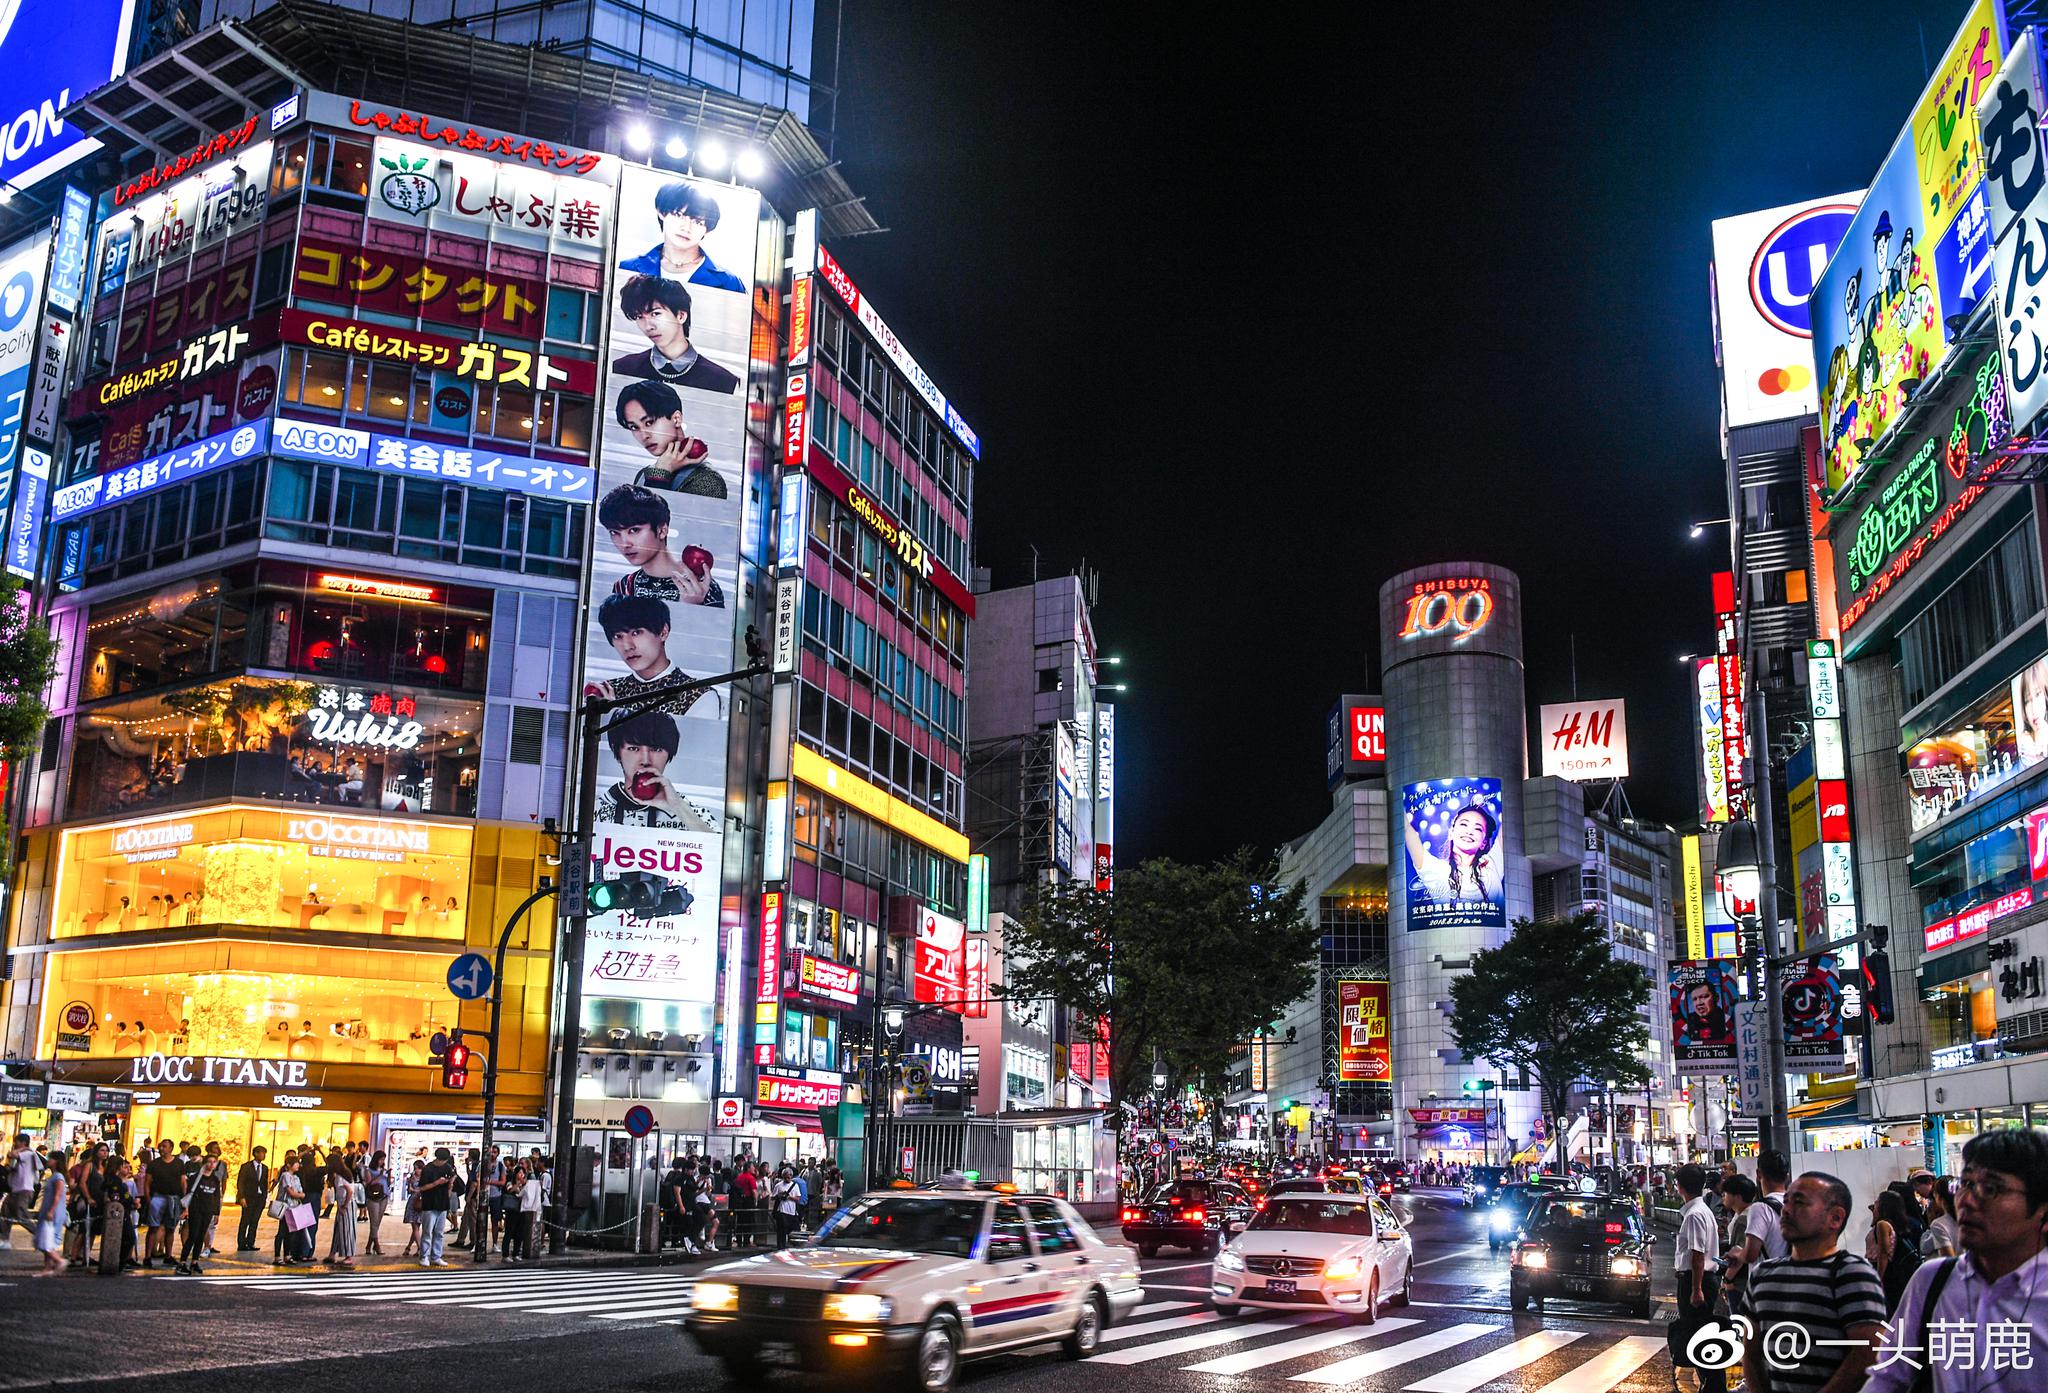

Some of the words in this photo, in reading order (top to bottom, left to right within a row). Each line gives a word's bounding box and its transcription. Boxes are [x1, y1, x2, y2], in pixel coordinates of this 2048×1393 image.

[1920, 26, 1993, 185] フレンズ
[350, 101, 601, 175] しゃぶしゃぶバイキング
[456, 176, 600, 238] しゃぶ葉
[1984, 80, 2048, 392] もんじ
[298, 247, 538, 322] コンタクト
[122, 268, 248, 351] プライス
[181, 325, 249, 380] ガスト
[456, 343, 568, 391] ガスト
[36, 345, 60, 425] 献血ルーム
[34, 427, 48, 439] 6F
[143, 395, 226, 457] ガスト
[788, 412, 803, 456] ガスト
[57, 484, 96, 514] AEON
[106, 441, 226, 500] 英会話イーオン
[282, 428, 358, 459] AEON
[376, 439, 588, 492] 英会話イーオン
[1884, 460, 1937, 552] 西村
[897, 529, 934, 579] ガスト
[1415, 579, 1489, 594] SHIBUYA
[778, 586, 792, 664] 渋谷駅前ビル
[1398, 589, 1493, 641] 109
[318, 688, 366, 711] 渋谷
[370, 693, 417, 718] 焼肉
[1099, 711, 1110, 734] BIC
[1552, 709, 1615, 751] H&M
[1099, 737, 1110, 801] CAMERA
[1561, 757, 1597, 771] 150m
[1916, 751, 2012, 822] Euphoria
[115, 823, 194, 851] L'OCCITANE
[289, 819, 429, 850] L'OCCITANE
[591, 837, 703, 874] Jesus
[657, 839, 675, 847] NEW
[1839, 855, 1849, 886] フルーツ
[656, 921, 674, 930] FRI
[762, 923, 776, 996] サンドラッグ
[924, 948, 956, 981] アコム
[934, 987, 945, 1001] 3F
[1697, 1050, 1711, 1058] Tik
[1713, 1049, 1729, 1057] Tok
[1741, 1010, 1759, 1099] 文化村通り
[1812, 1046, 1830, 1054] Tok
[780, 1084, 829, 1106] サンドラッグ
